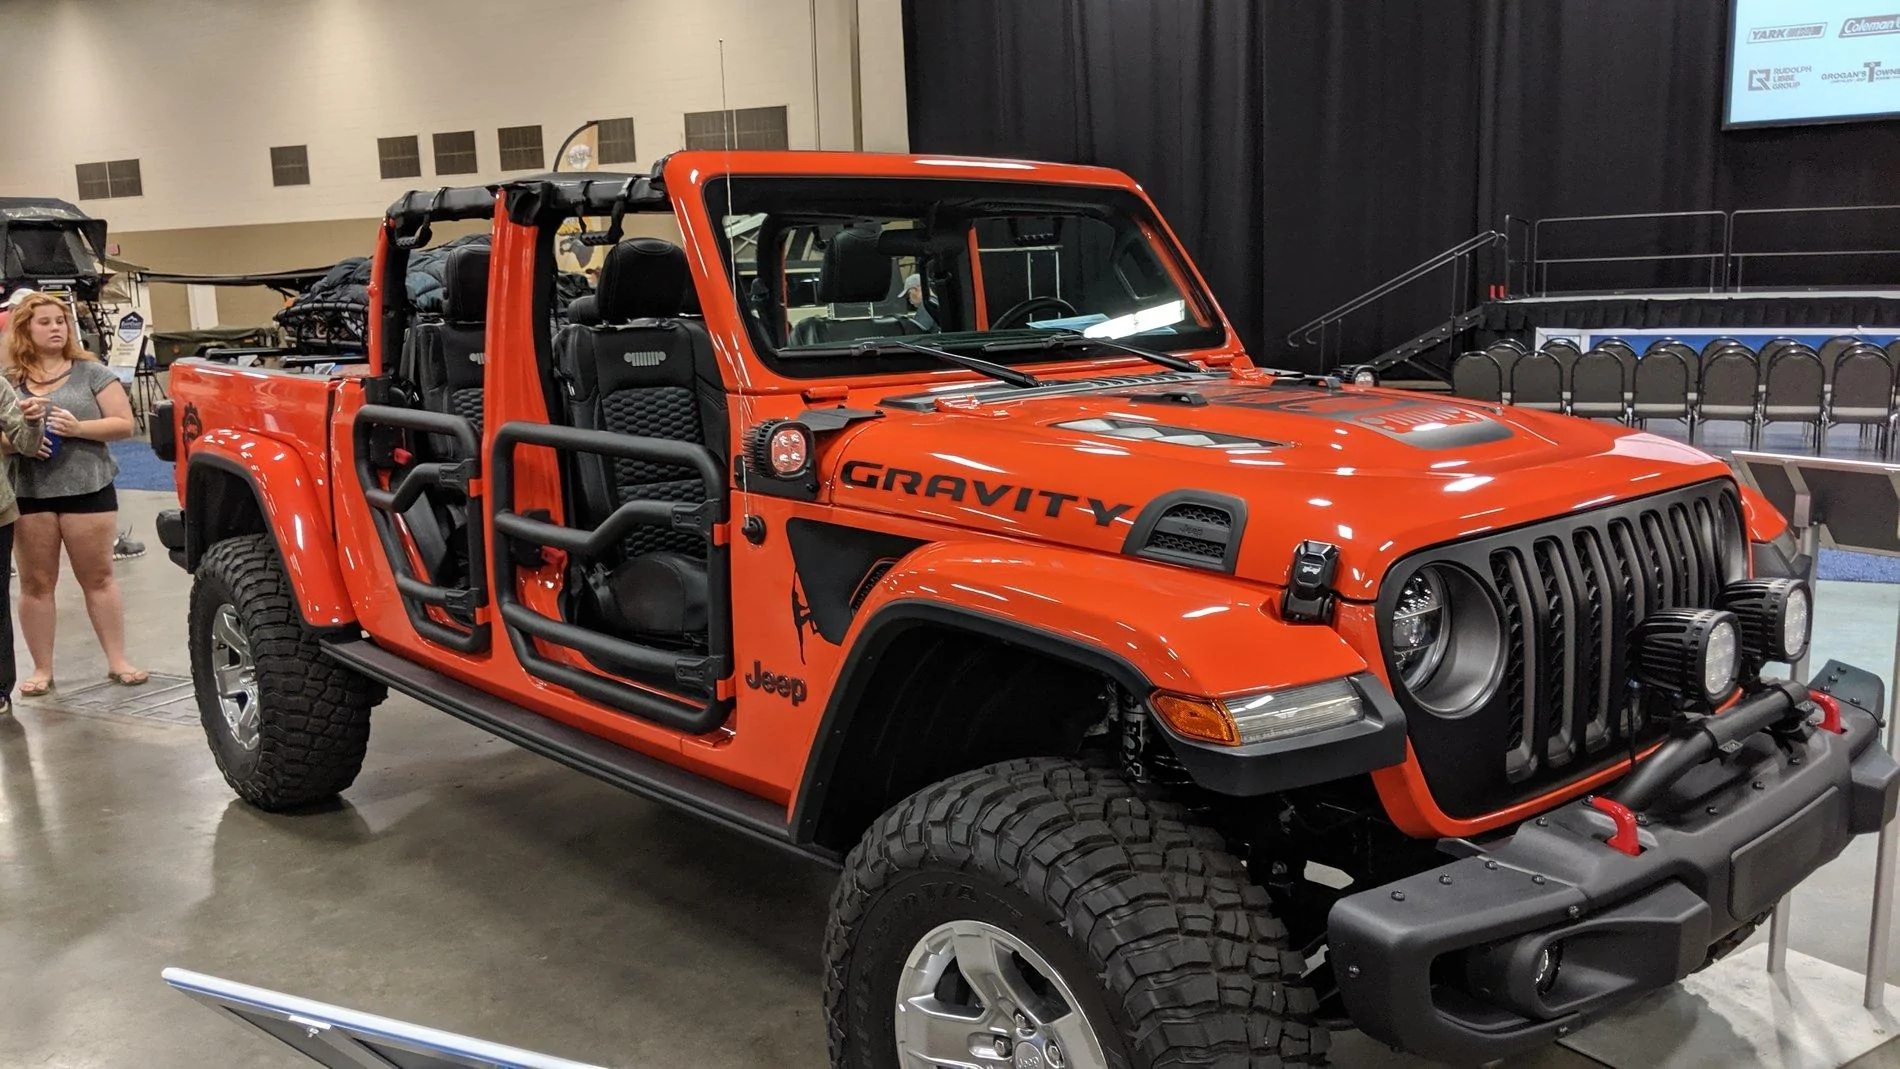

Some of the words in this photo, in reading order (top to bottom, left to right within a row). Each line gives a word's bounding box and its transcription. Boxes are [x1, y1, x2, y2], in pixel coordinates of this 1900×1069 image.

[1844, 19, 1895, 34] Coleman
[1752, 28, 1787, 40] YARK
[1773, 65, 1812, 74] RUDOLPH
[1772, 74, 1796, 82] LIBBE
[1772, 81, 1801, 90] GROUP
[839, 460, 1135, 527] GRAVITY
[745, 659, 808, 708] Jeep
